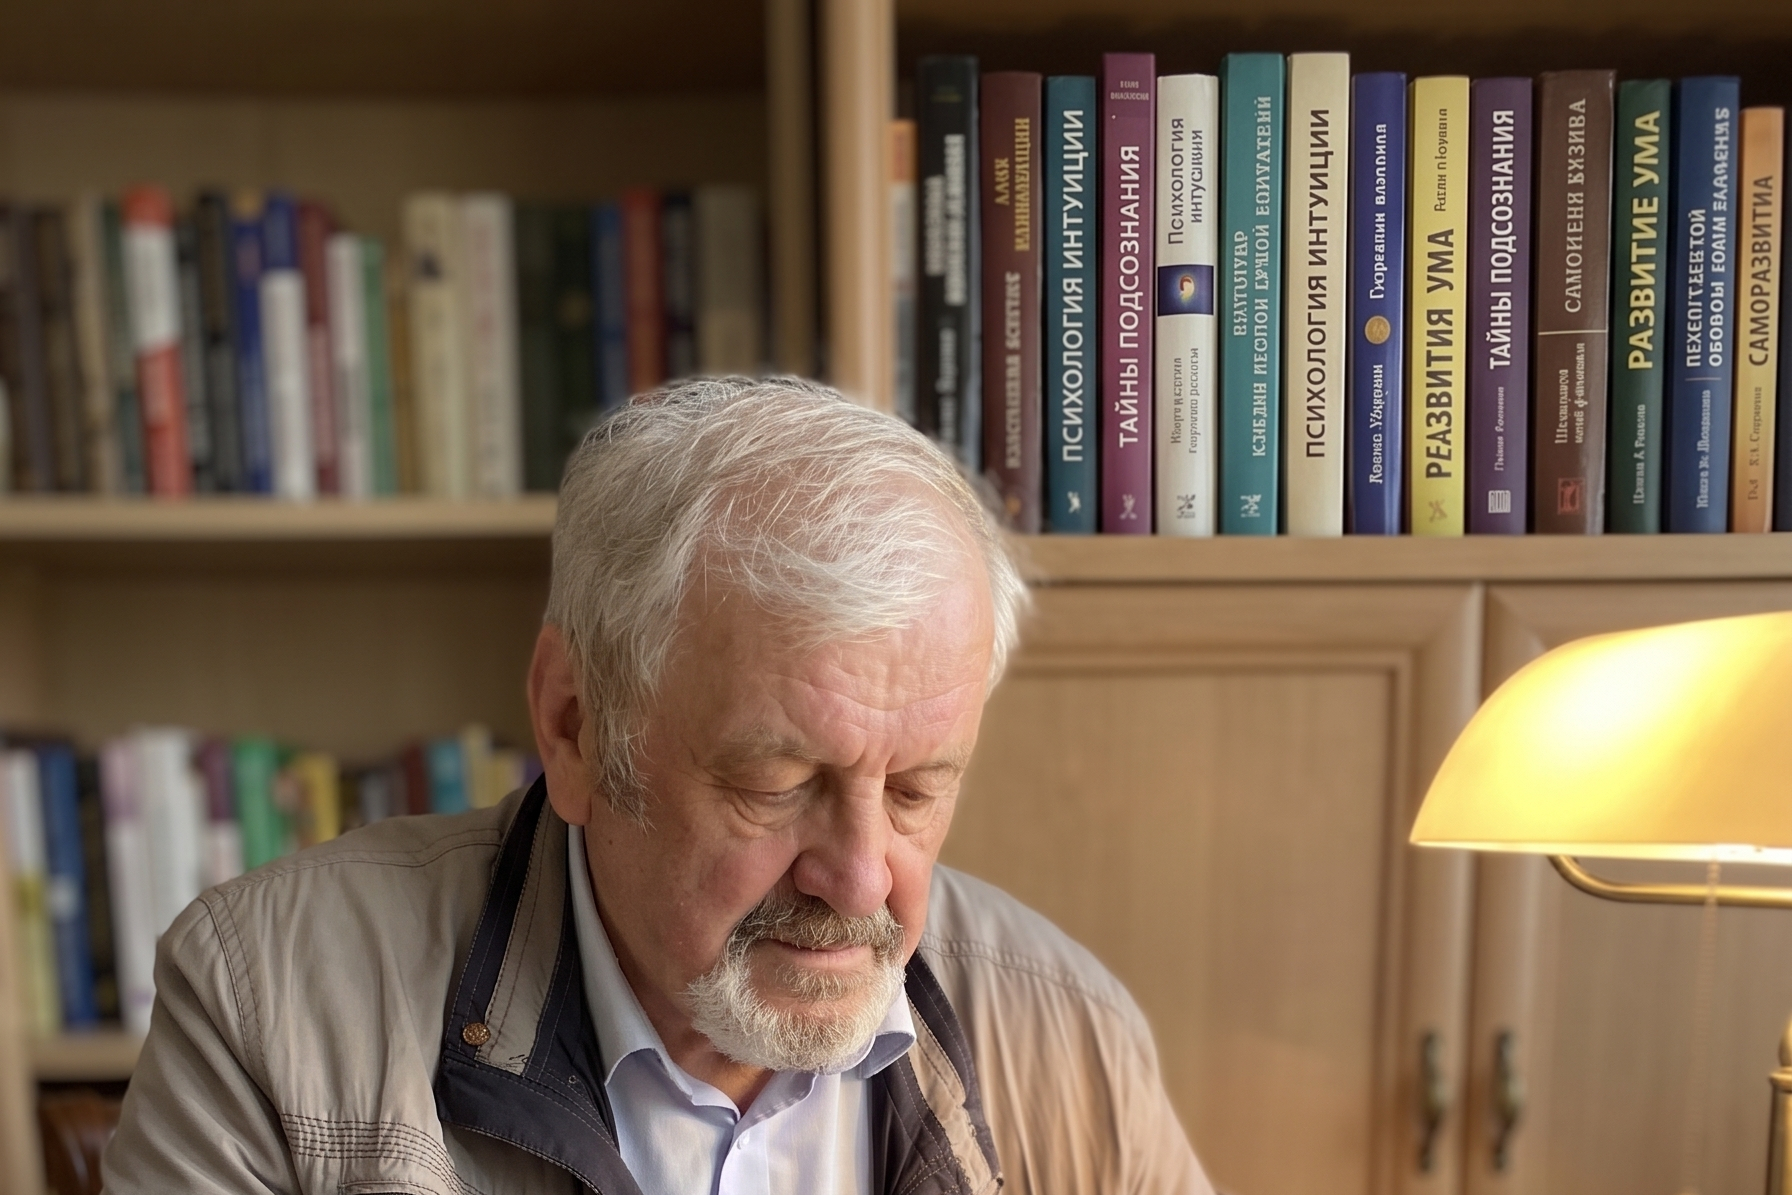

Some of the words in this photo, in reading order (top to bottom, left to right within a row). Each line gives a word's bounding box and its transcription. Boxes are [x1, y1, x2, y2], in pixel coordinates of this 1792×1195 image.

[1062, 109, 1088, 269] ИНТУИЦИИ
[1168, 118, 1185, 245] Психология
[1308, 109, 1333, 266] ИНТУИЦИИ
[1490, 110, 1517, 283] ПОДСОЗНАНИЯ
[1633, 111, 1661, 187] УМА
[1119, 145, 1143, 349] ПОДСОЗНАНИЯ
[1427, 228, 1455, 293] УМА
[1628, 197, 1659, 370] РАЗВИТИЕ
[1062, 277, 1084, 462] ПСИХОЛОГИЯ
[1115, 357, 1139, 448] ТАЙНЫ
[1306, 275, 1329, 458] ПСИХОЛОГИЯ
[1425, 308, 1454, 479] РЕАЗВИТИЯ
[1486, 291, 1512, 370] ТАЙНЫ
